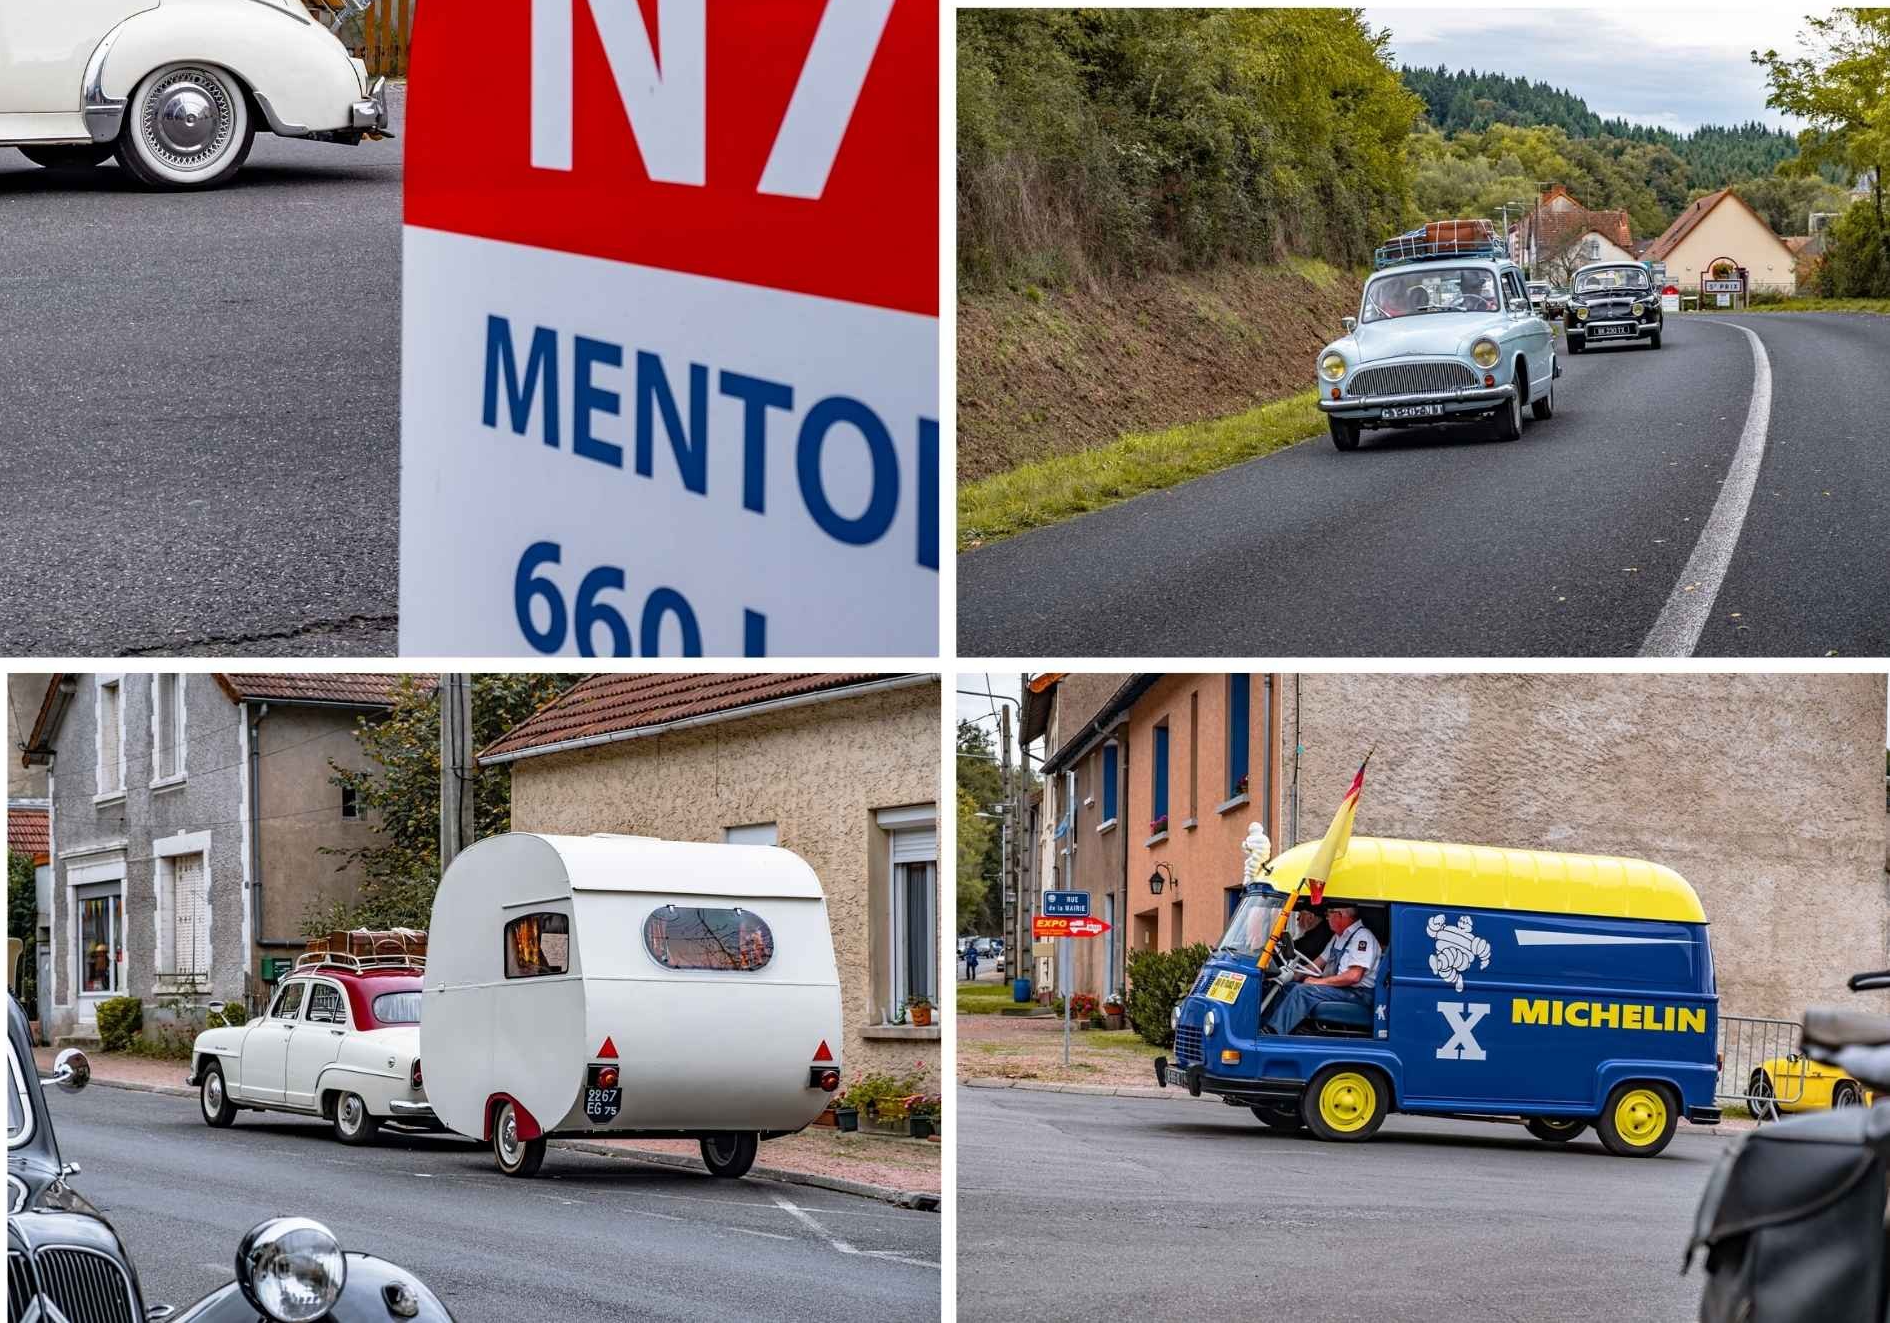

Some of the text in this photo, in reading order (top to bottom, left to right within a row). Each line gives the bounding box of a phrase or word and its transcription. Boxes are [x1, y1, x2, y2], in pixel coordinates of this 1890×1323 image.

[1036, 920, 1068, 928] EXPO
[1512, 998, 1706, 1034] MICHELIN
[1436, 1002, 1490, 1061] X
[588, 1090, 617, 1102] 2267
[586, 1102, 617, 1115] EG 75
